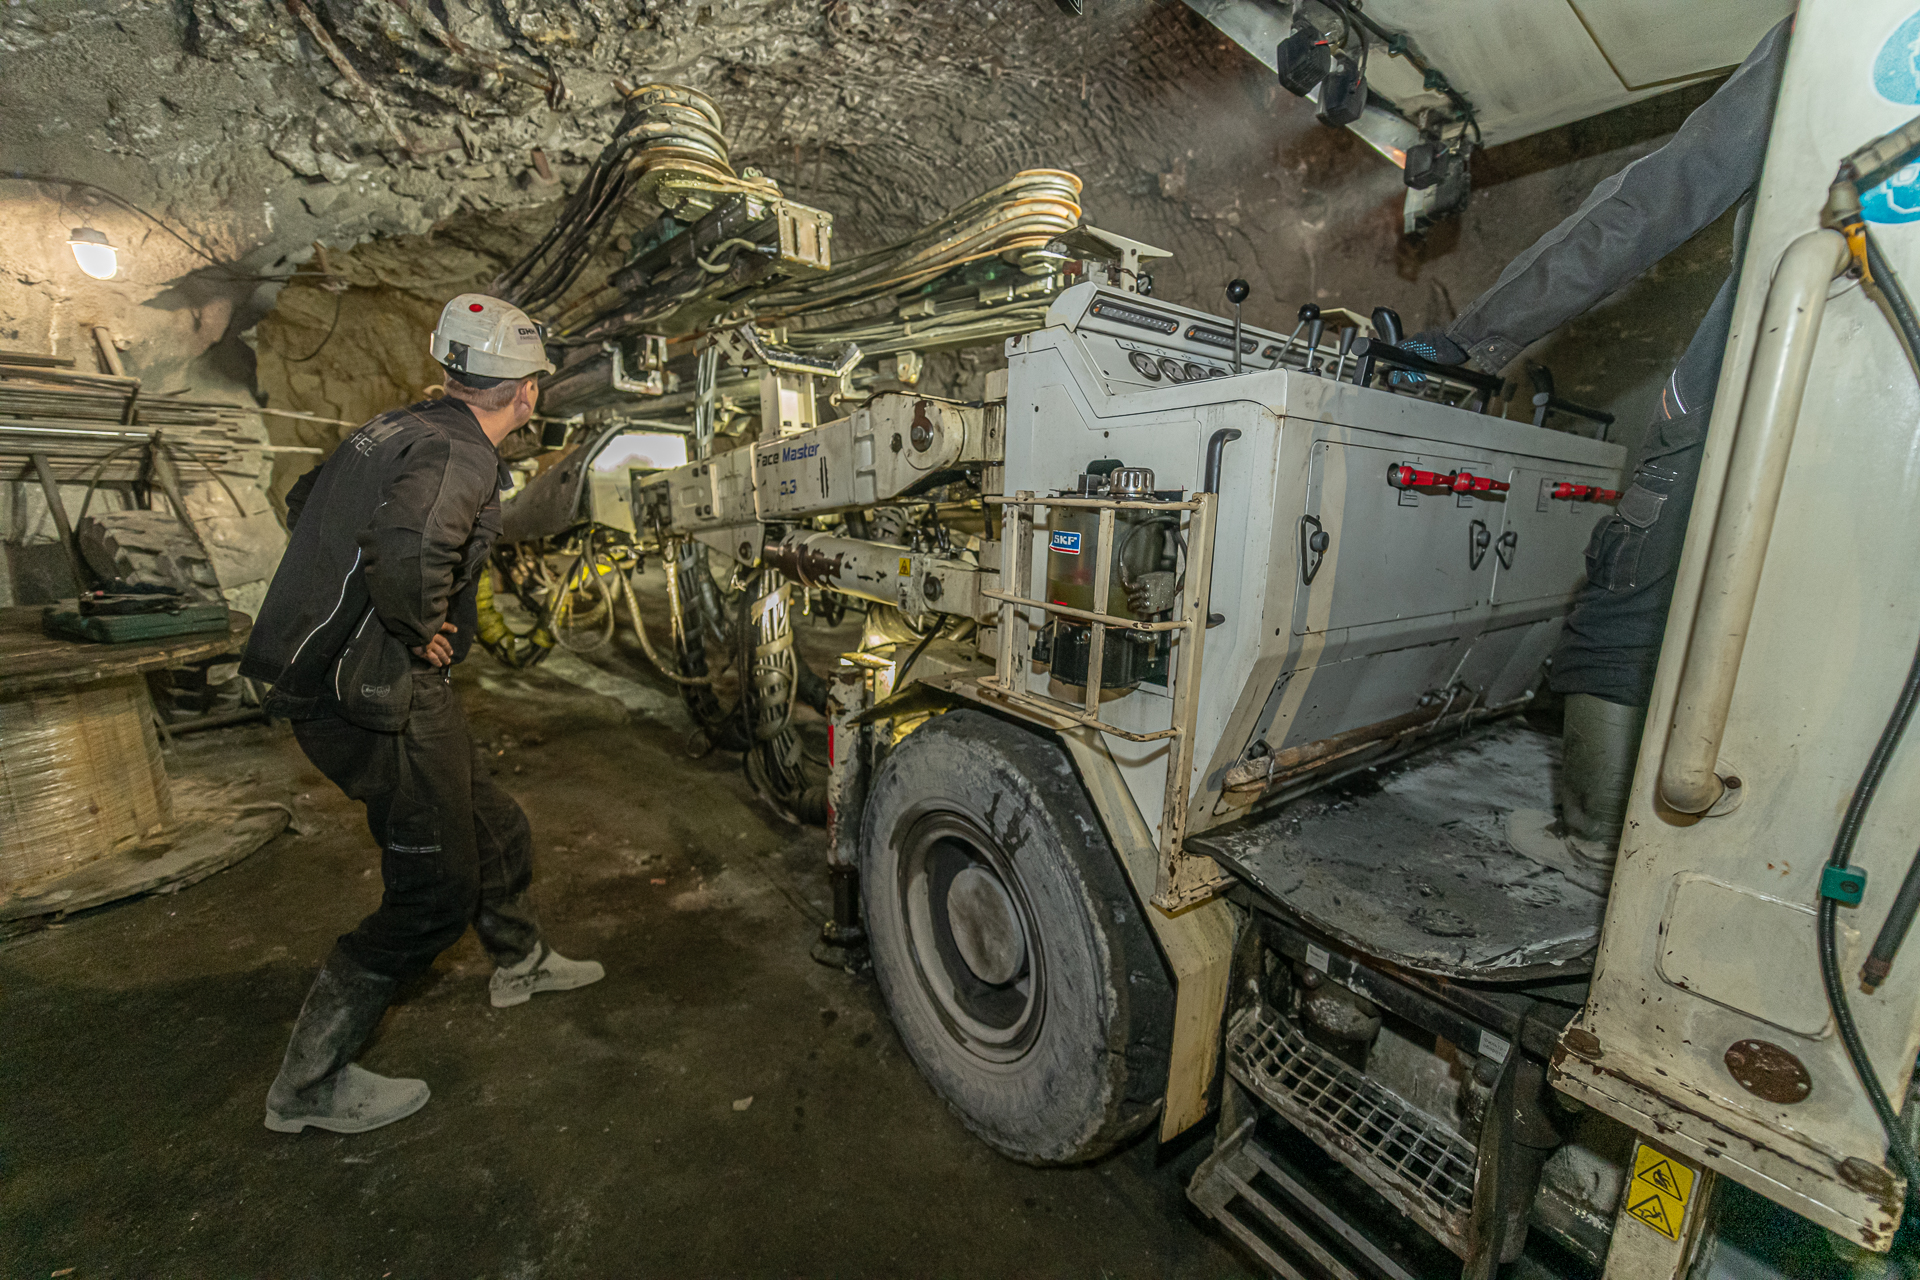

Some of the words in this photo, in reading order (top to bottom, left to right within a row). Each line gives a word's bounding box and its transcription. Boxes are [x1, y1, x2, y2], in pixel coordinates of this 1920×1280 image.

[756, 452, 779, 467] Face
[782, 443, 820, 462] Master
[1053, 534, 1078, 546] SKF
